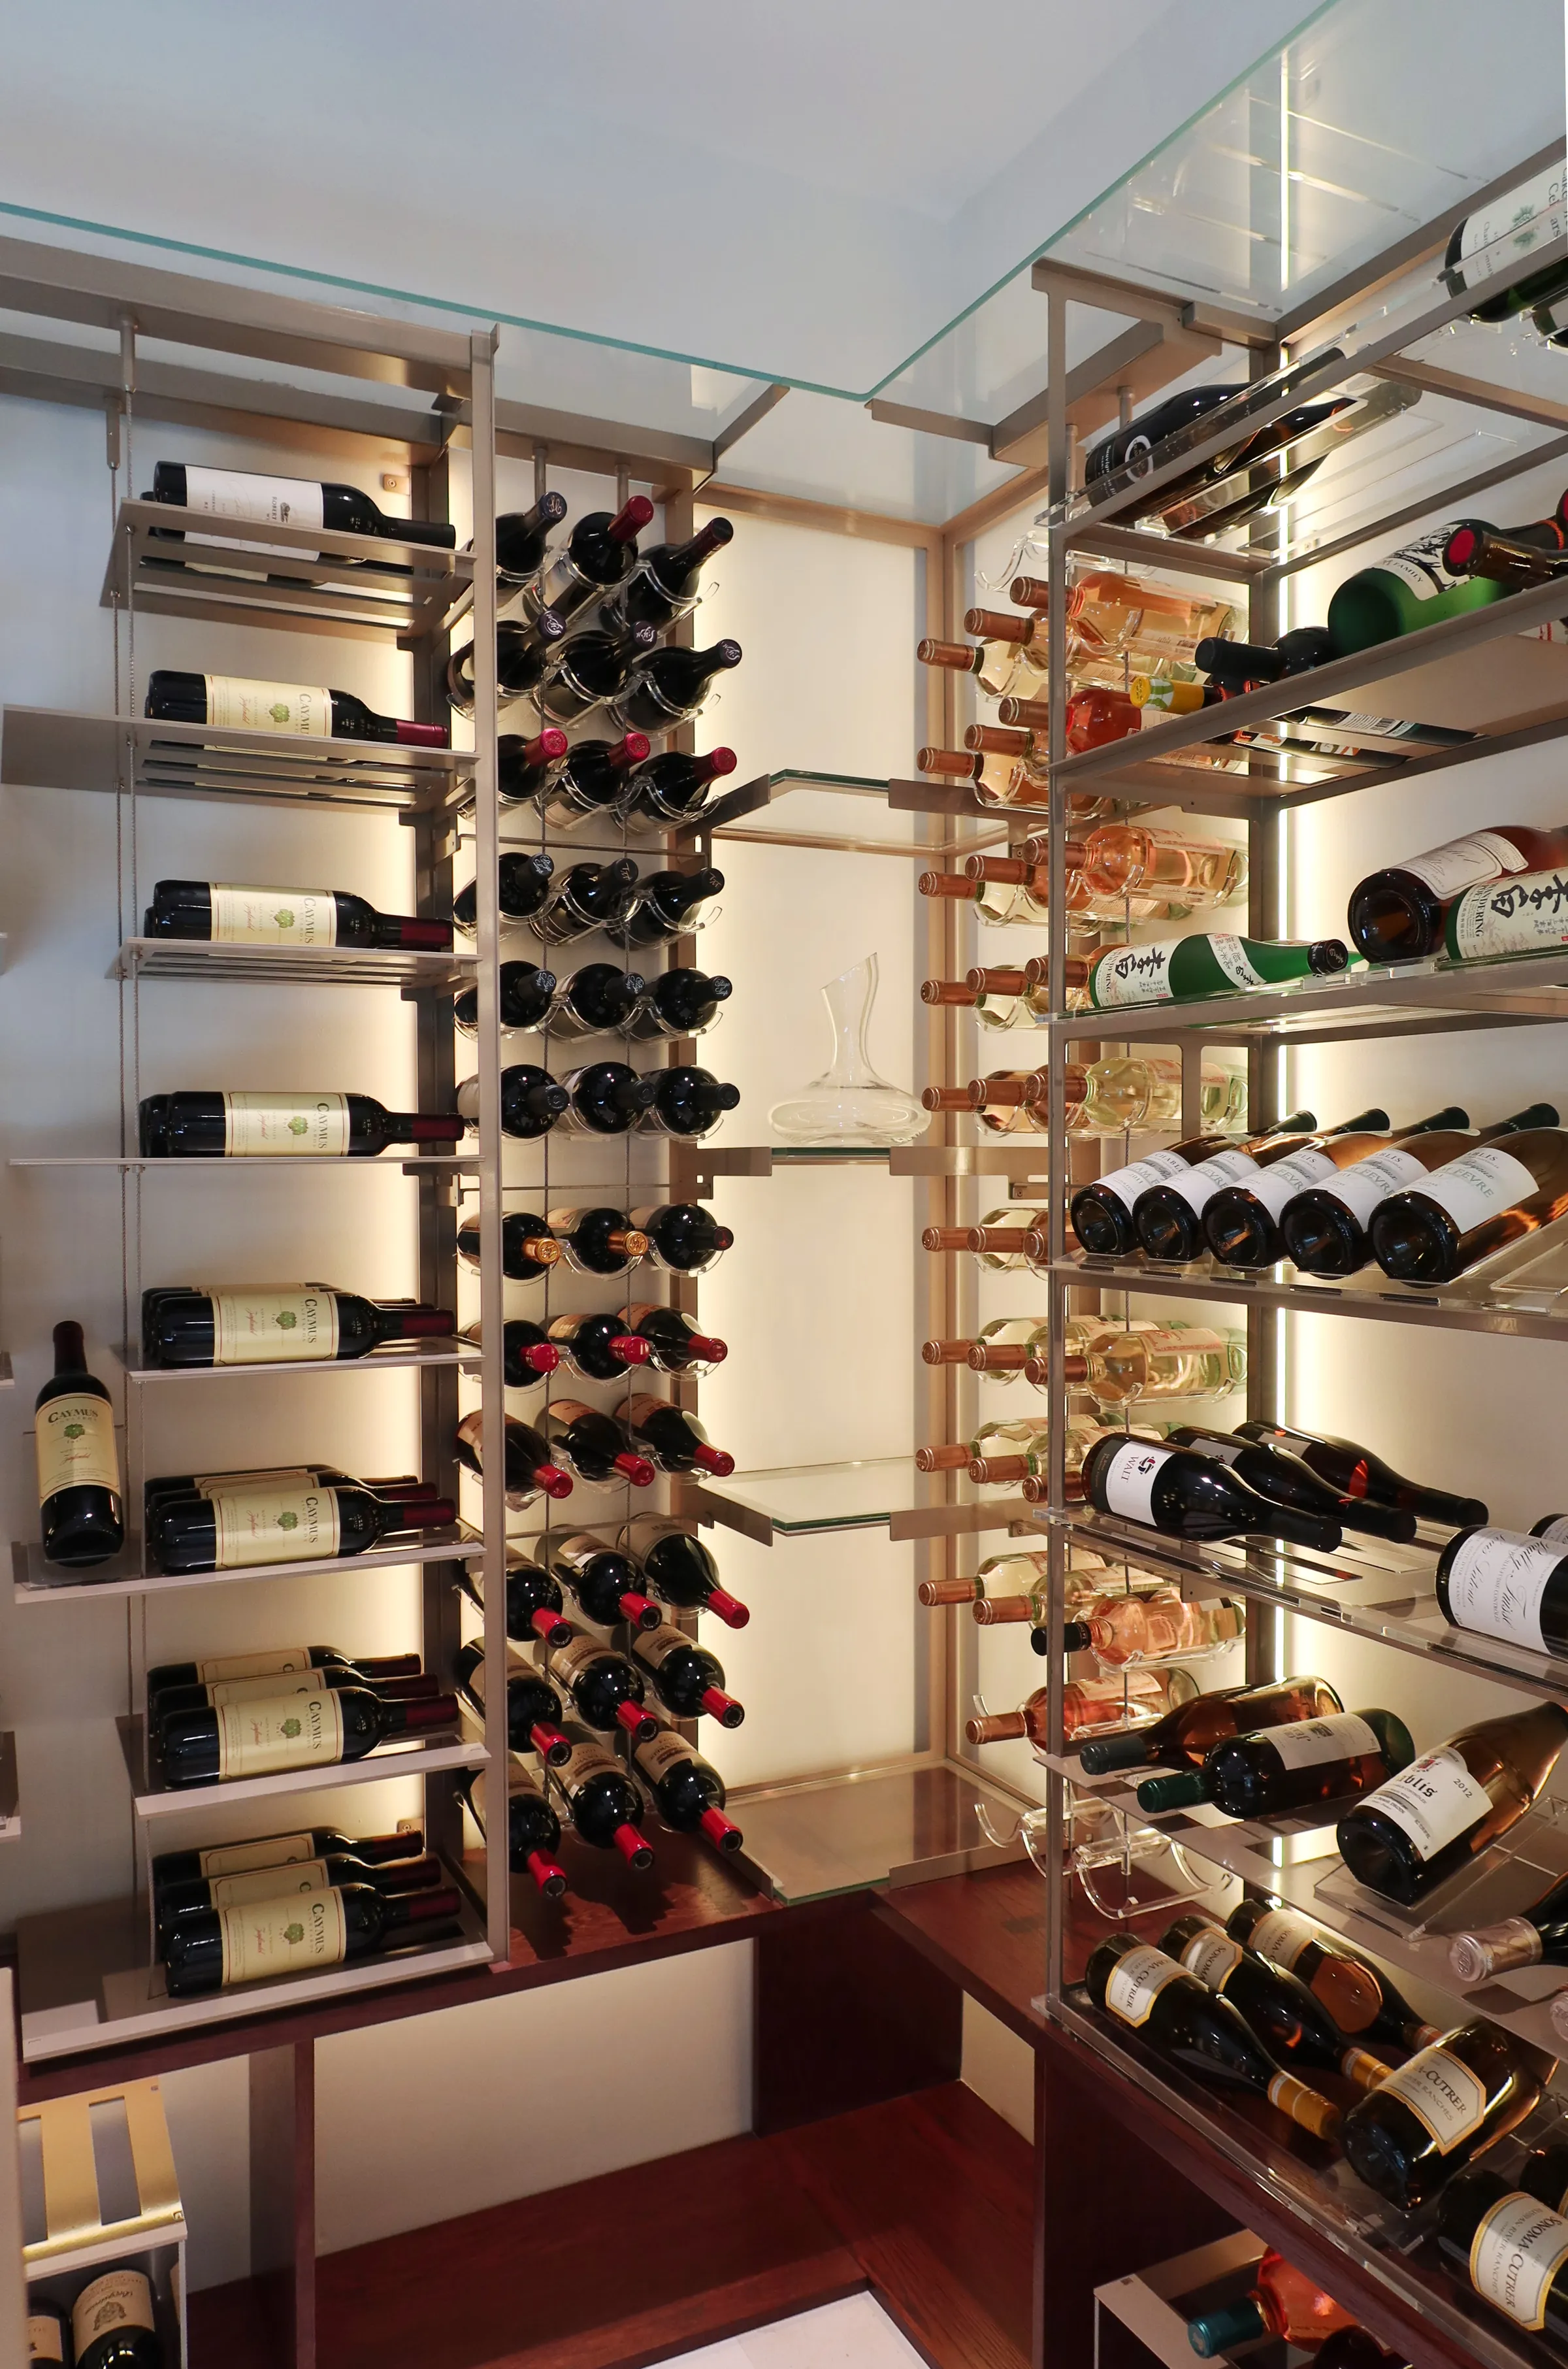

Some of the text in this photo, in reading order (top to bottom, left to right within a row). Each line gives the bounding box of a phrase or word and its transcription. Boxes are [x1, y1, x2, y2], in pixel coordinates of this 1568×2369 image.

[1392, 561, 1424, 583] FAMILY
[303, 897, 316, 944] CAYMUS
[317, 1102, 330, 1149] CAYMUS
[1453, 1168, 1495, 1199] FEVRE
[1462, 1158, 1495, 1180] Royaux
[304, 1299, 318, 1344] CAYMUS
[48, 1408, 99, 1423] CAYMUS
[1120, 1455, 1139, 1482] WALT
[305, 1497, 319, 1544] CAYMUS
[308, 1701, 322, 1750] CAYMUS
[1452, 1778, 1473, 1799] 2012
[312, 1902, 325, 1954] CAYMUS
[1505, 2215, 1563, 2309] SONOMA-CUTRER
